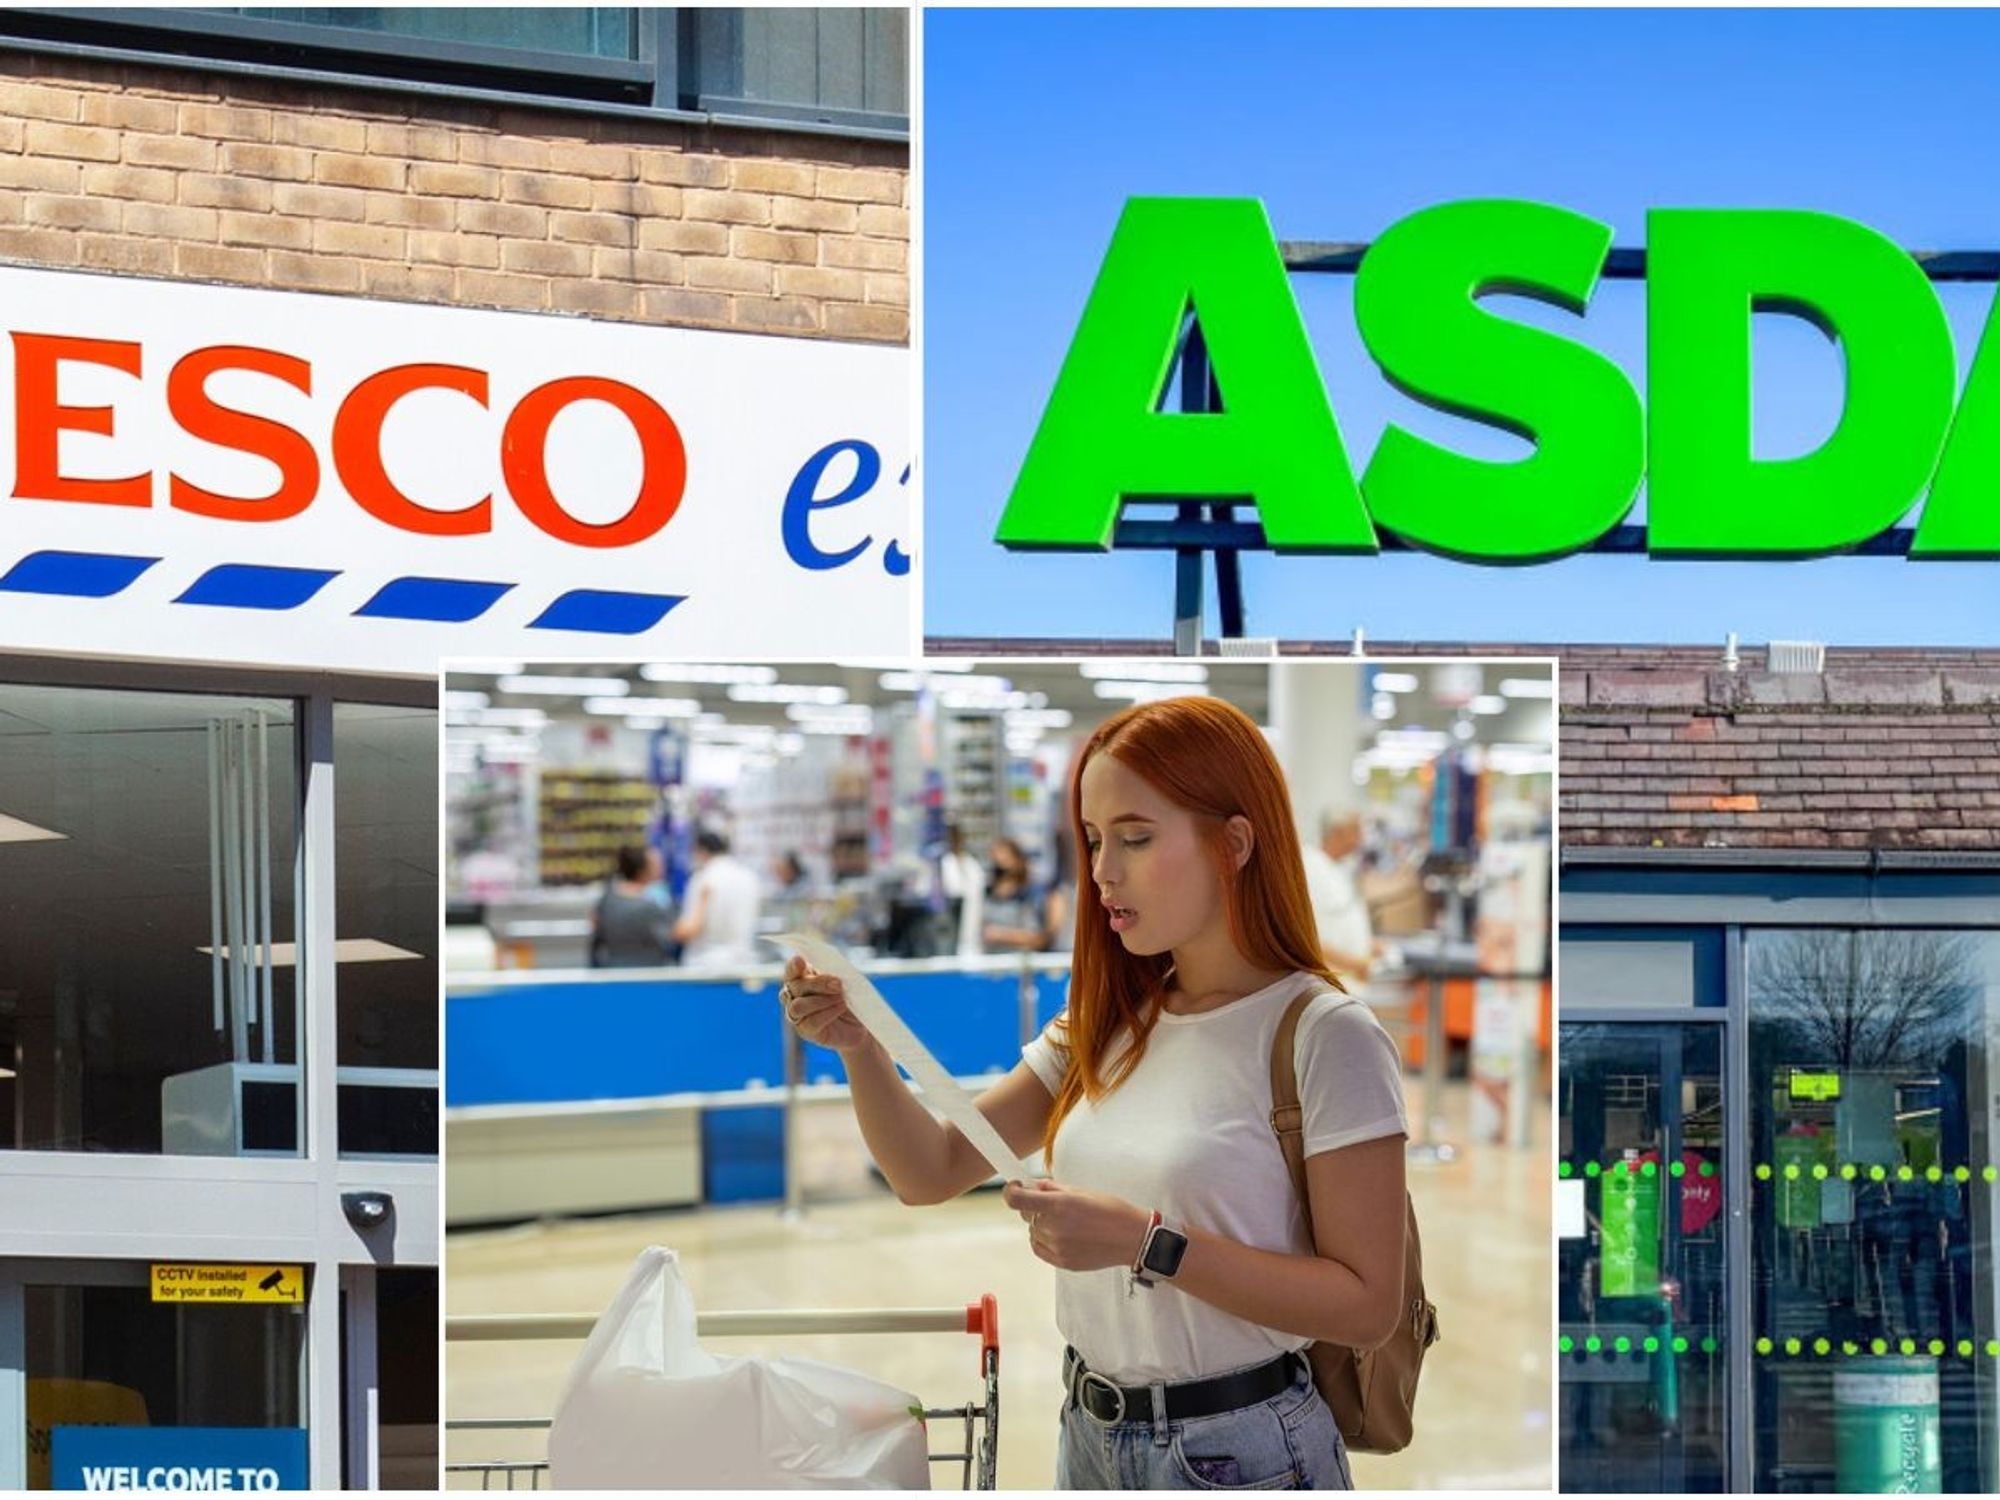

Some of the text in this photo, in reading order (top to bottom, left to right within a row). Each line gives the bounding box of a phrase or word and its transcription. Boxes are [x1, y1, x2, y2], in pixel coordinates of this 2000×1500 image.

[994, 195, 2000, 562] ASD
[157, 1267, 248, 1282] CCTV installed
[160, 1284, 245, 1299] for your safety
[81, 1466, 281, 1491] WELCOME TO
